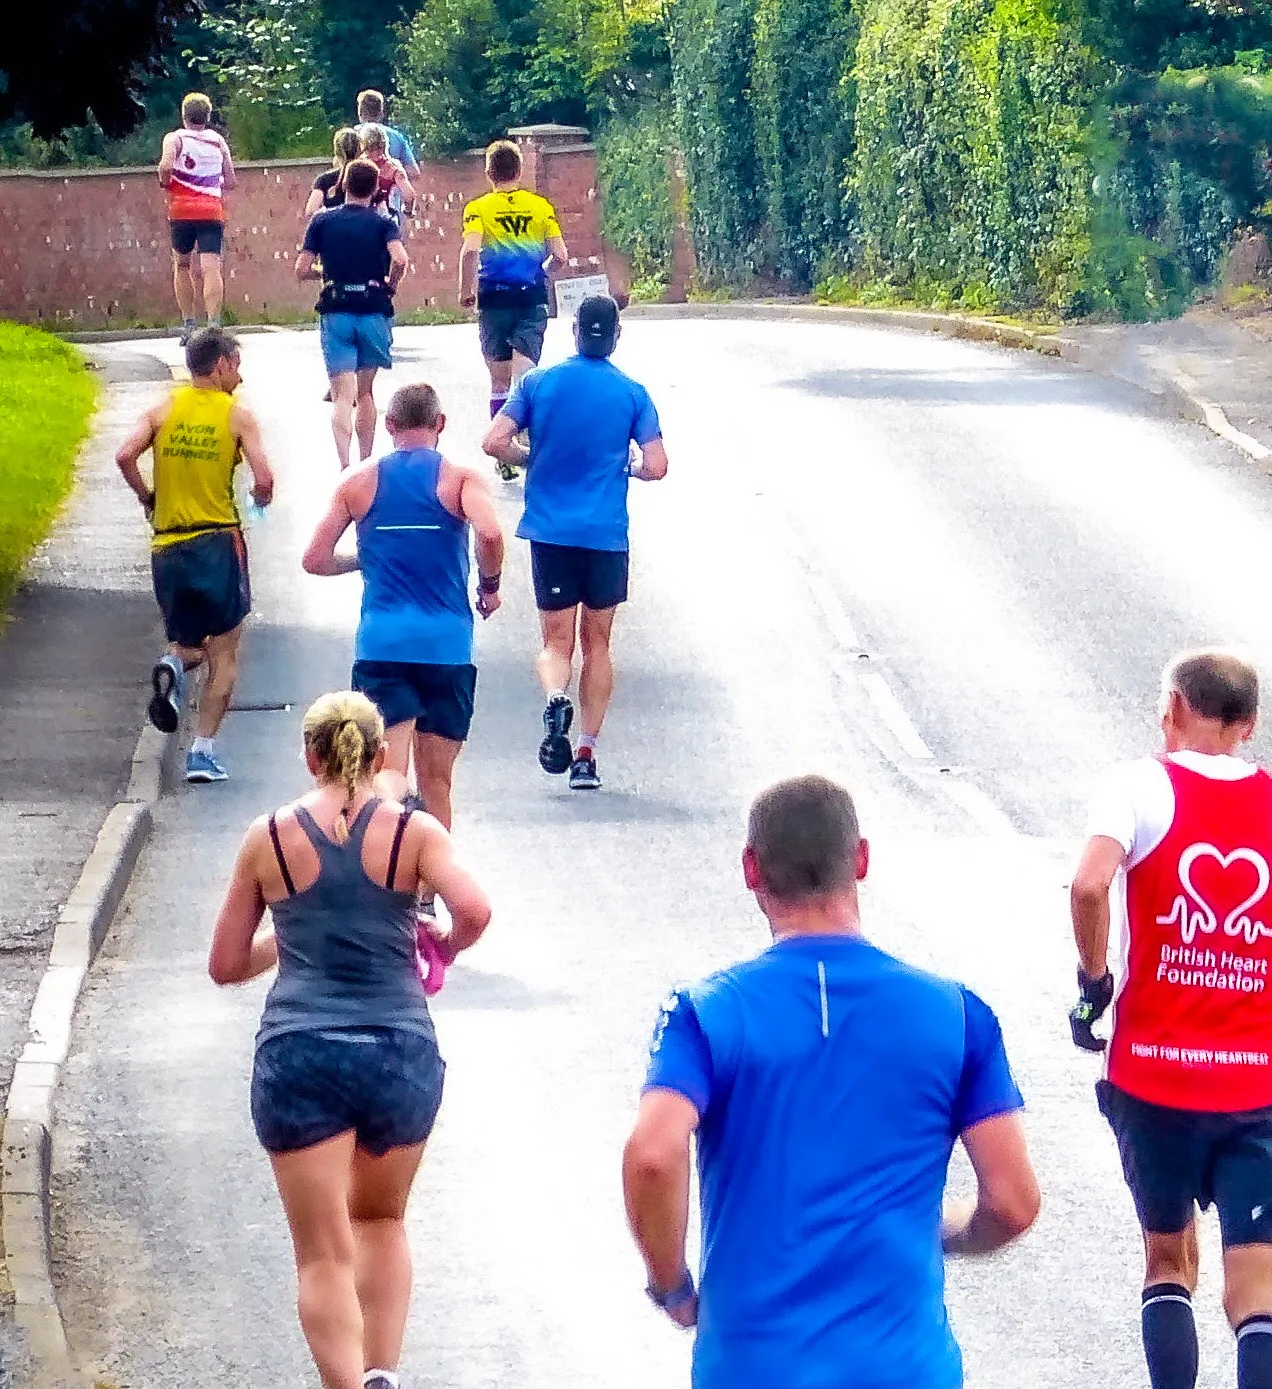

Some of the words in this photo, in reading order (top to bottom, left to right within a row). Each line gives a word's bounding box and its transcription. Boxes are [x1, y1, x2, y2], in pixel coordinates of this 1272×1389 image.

[169, 434, 218, 448] VALLEY
[1161, 944, 1216, 968] British
[1221, 951, 1268, 975] Heart
[1156, 962, 1265, 993] Foundation
[1160, 1045, 1180, 1061] FOR
[1181, 1048, 1213, 1063] EVERY
[1214, 1050, 1269, 1066] HEARTBEAT
